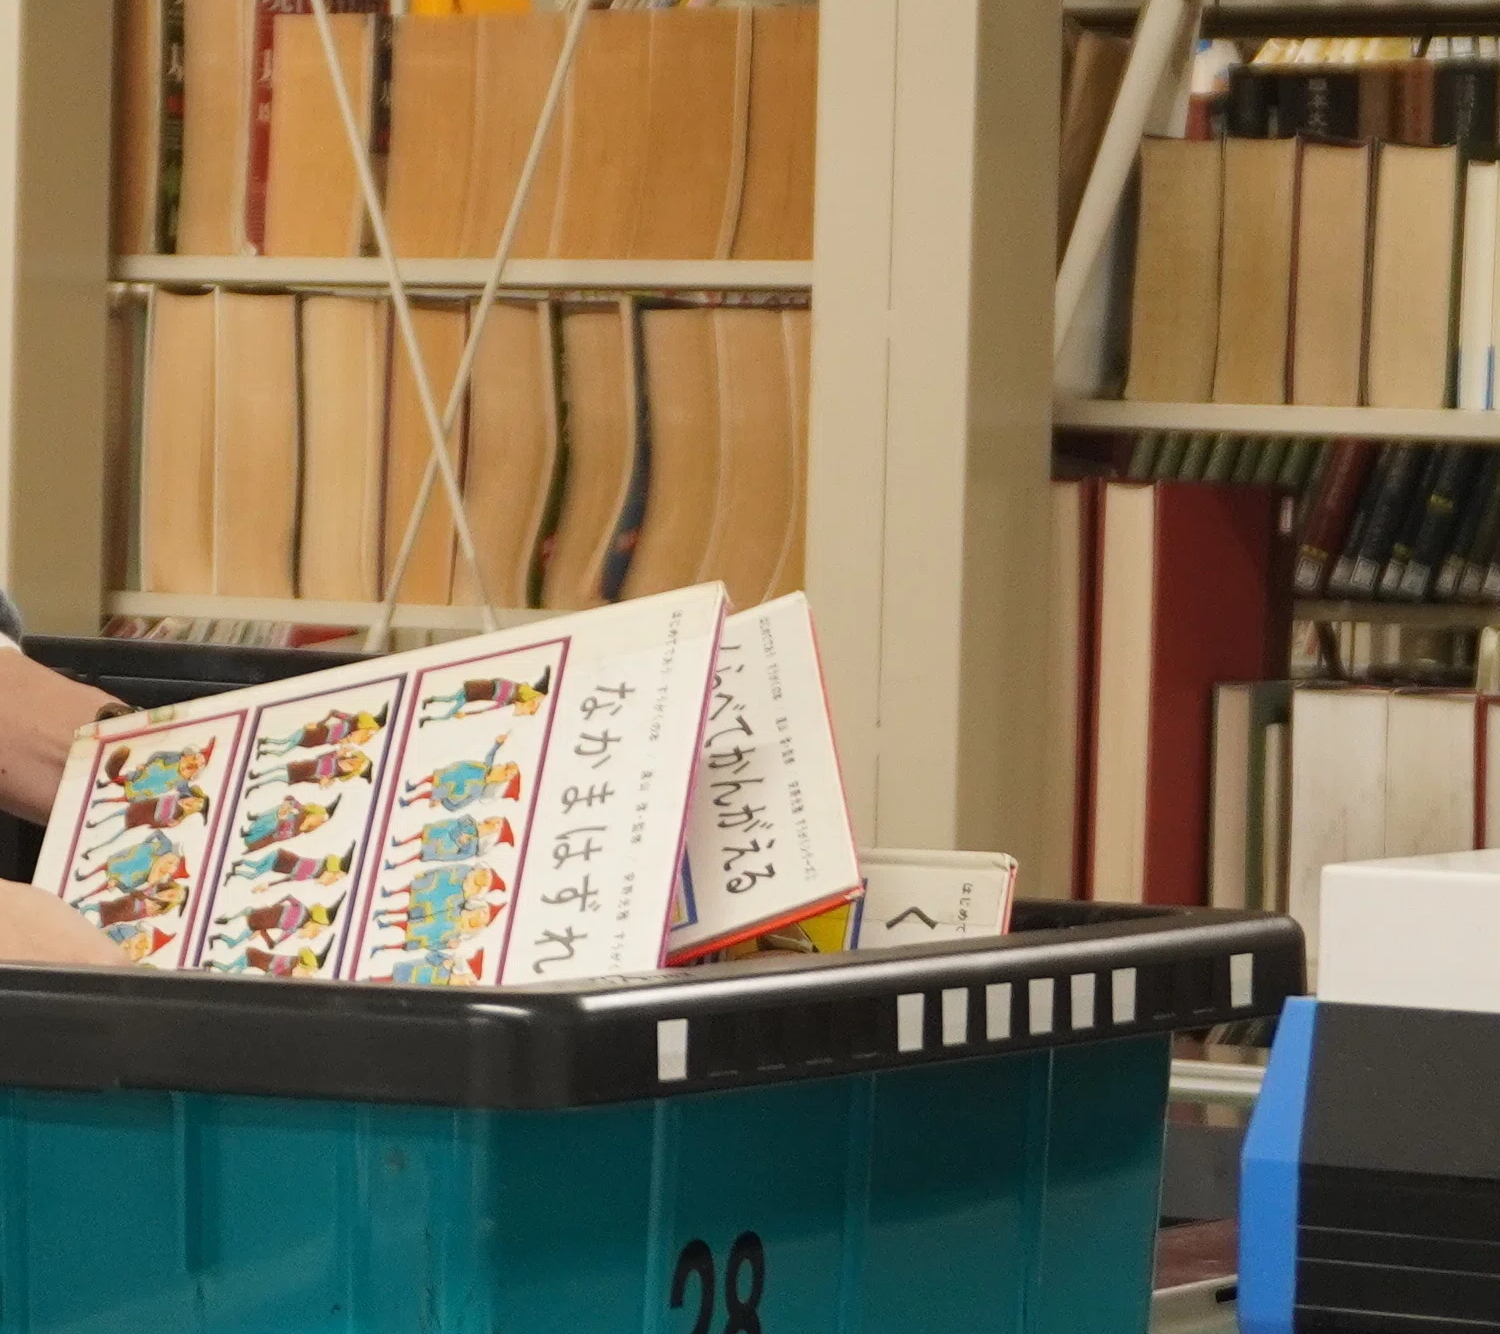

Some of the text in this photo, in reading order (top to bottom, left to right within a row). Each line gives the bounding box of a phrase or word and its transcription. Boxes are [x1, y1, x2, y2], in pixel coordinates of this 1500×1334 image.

[532, 680, 636, 975] なかまはずれ
